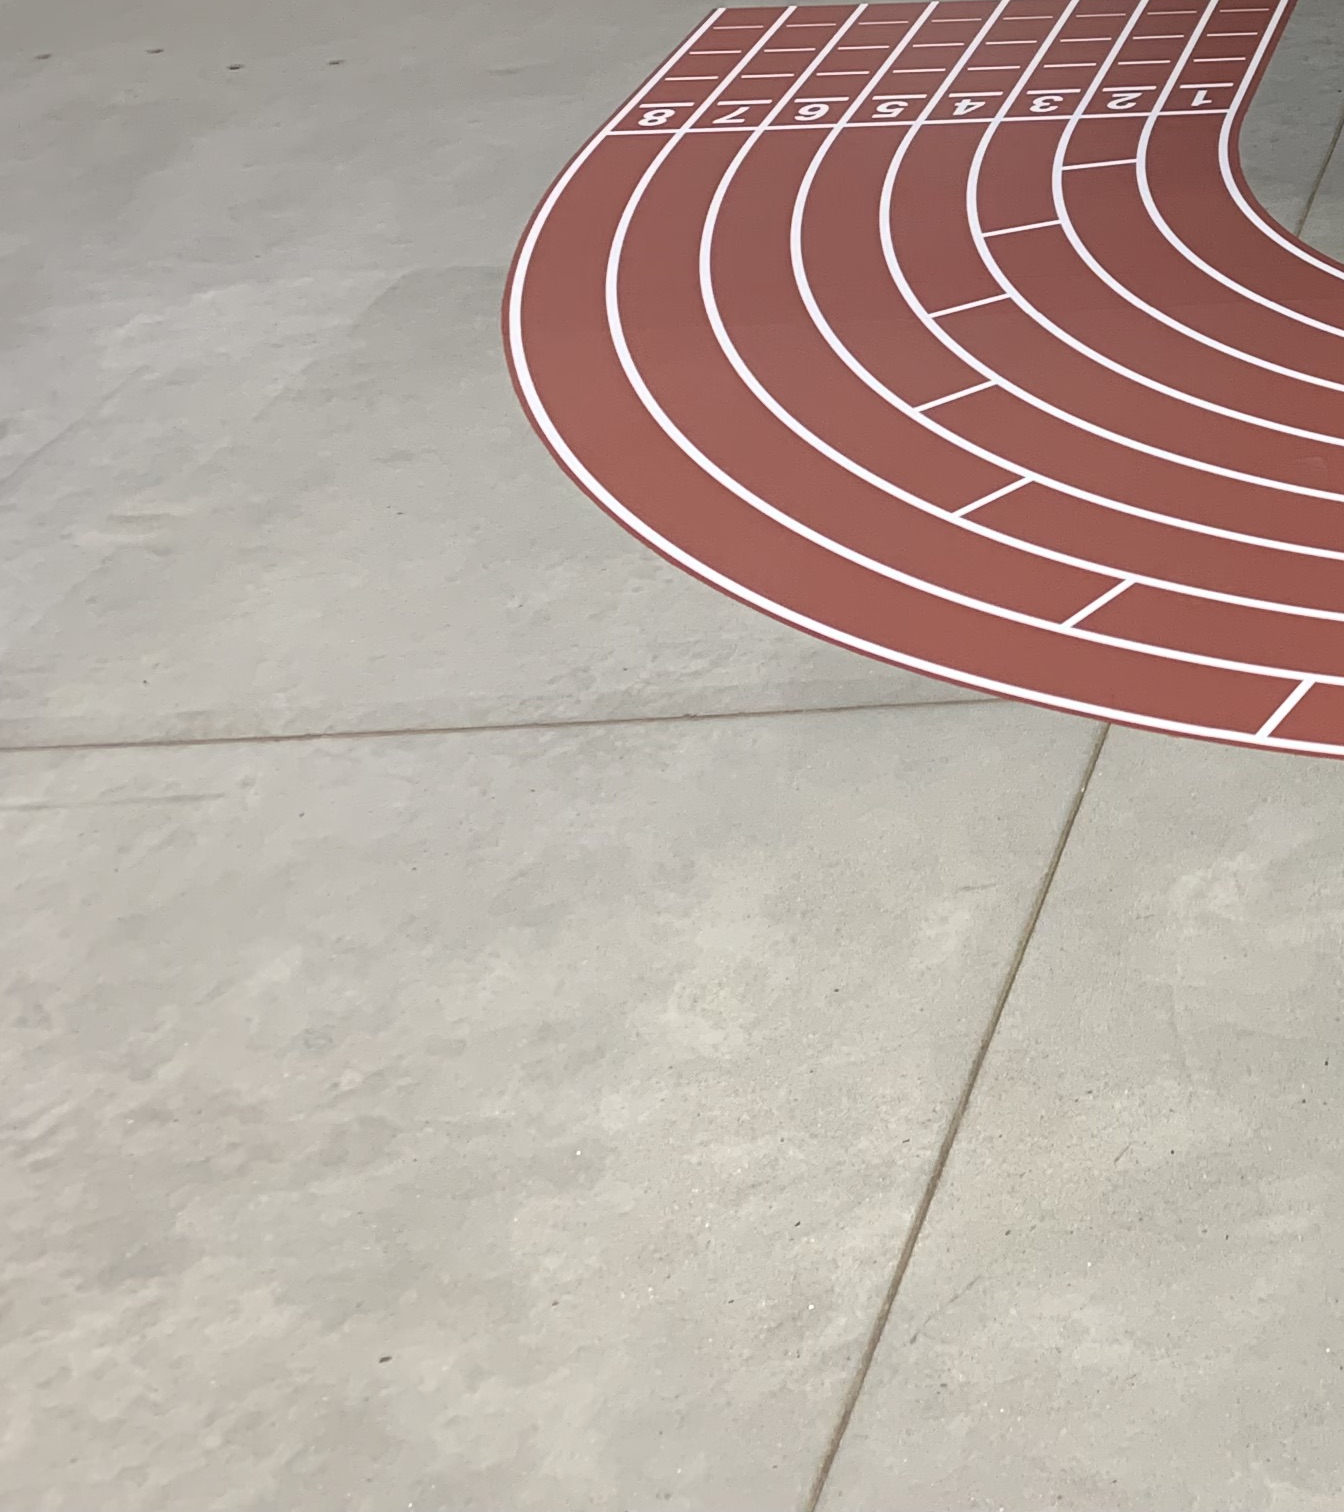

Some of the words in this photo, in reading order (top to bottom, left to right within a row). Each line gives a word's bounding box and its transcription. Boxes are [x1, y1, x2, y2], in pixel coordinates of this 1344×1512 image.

[953, 98, 986, 116] 4
[1030, 95, 1064, 113] 3
[1107, 92, 1143, 109] 2
[1191, 90, 1213, 107] 1
[638, 108, 675, 126] 8
[712, 106, 750, 125] 7
[794, 104, 830, 121] 6
[872, 101, 908, 119] 5
